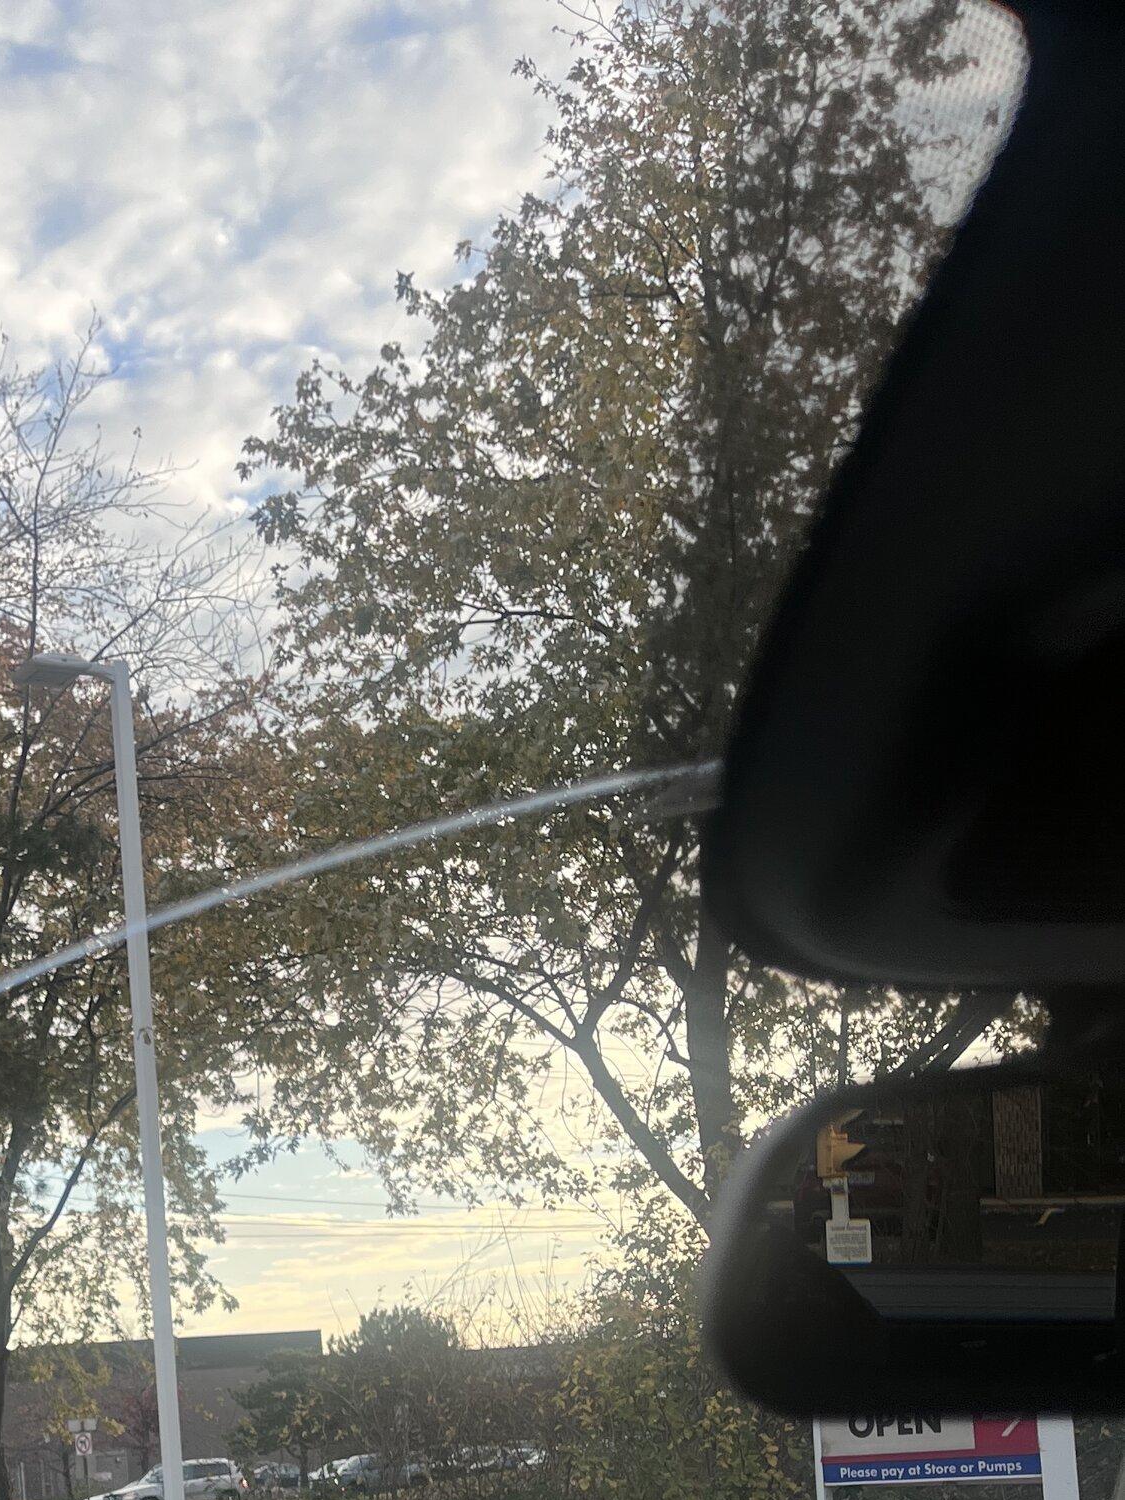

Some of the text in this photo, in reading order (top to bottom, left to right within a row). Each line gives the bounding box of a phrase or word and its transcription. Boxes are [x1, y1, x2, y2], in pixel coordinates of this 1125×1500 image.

[848, 1414, 942, 1438] OPEN
[840, 1460, 1022, 1481] Please pay at Store or Pumps
